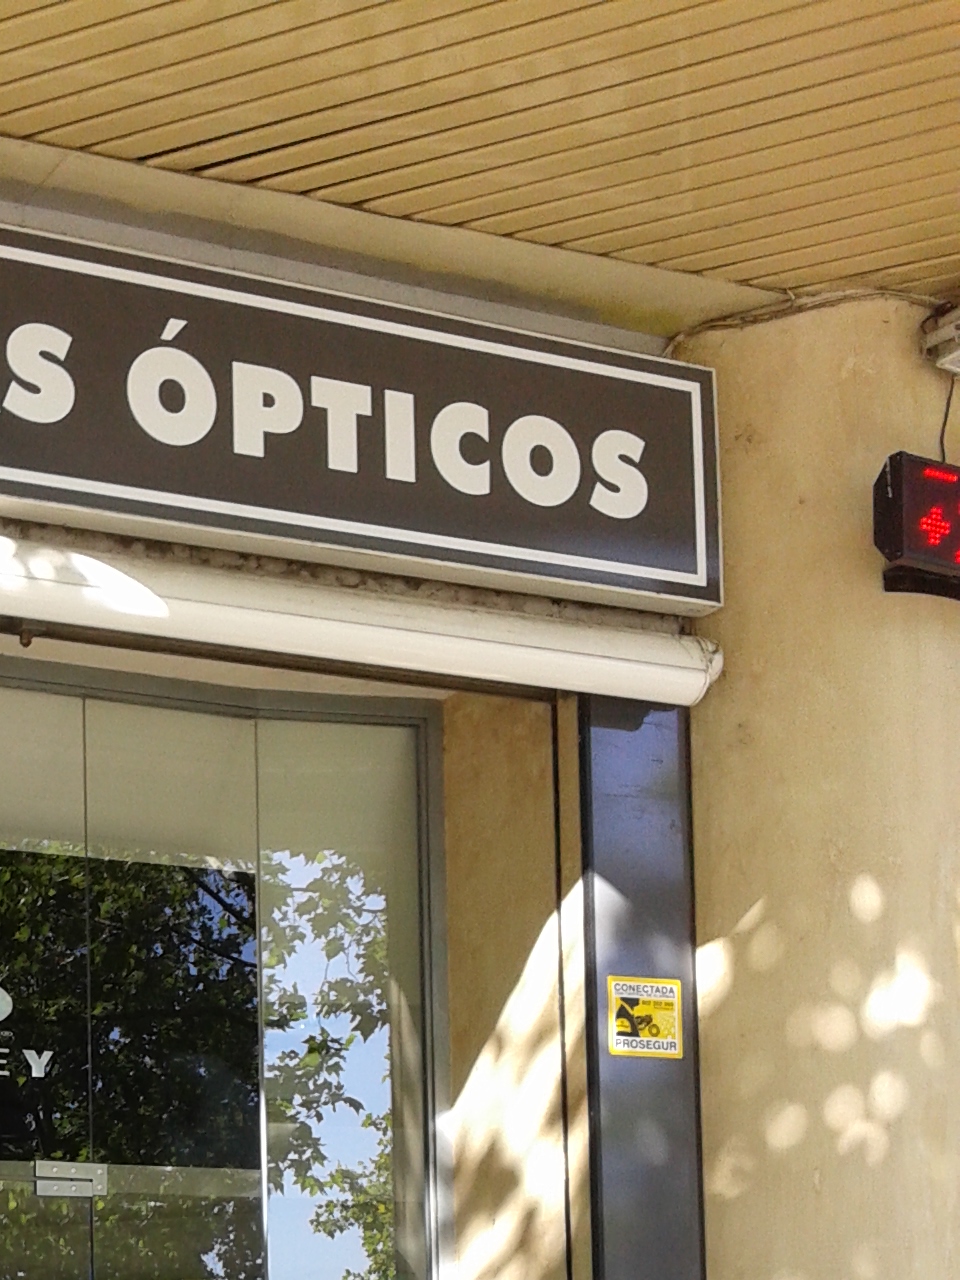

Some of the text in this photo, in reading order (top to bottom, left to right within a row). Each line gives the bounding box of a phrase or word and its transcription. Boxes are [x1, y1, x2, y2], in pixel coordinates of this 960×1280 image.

[126, 318, 649, 519] ÓPTICOS
[614, 983, 675, 994] CONECTADA
[615, 1039, 677, 1051] PROSEGUR
